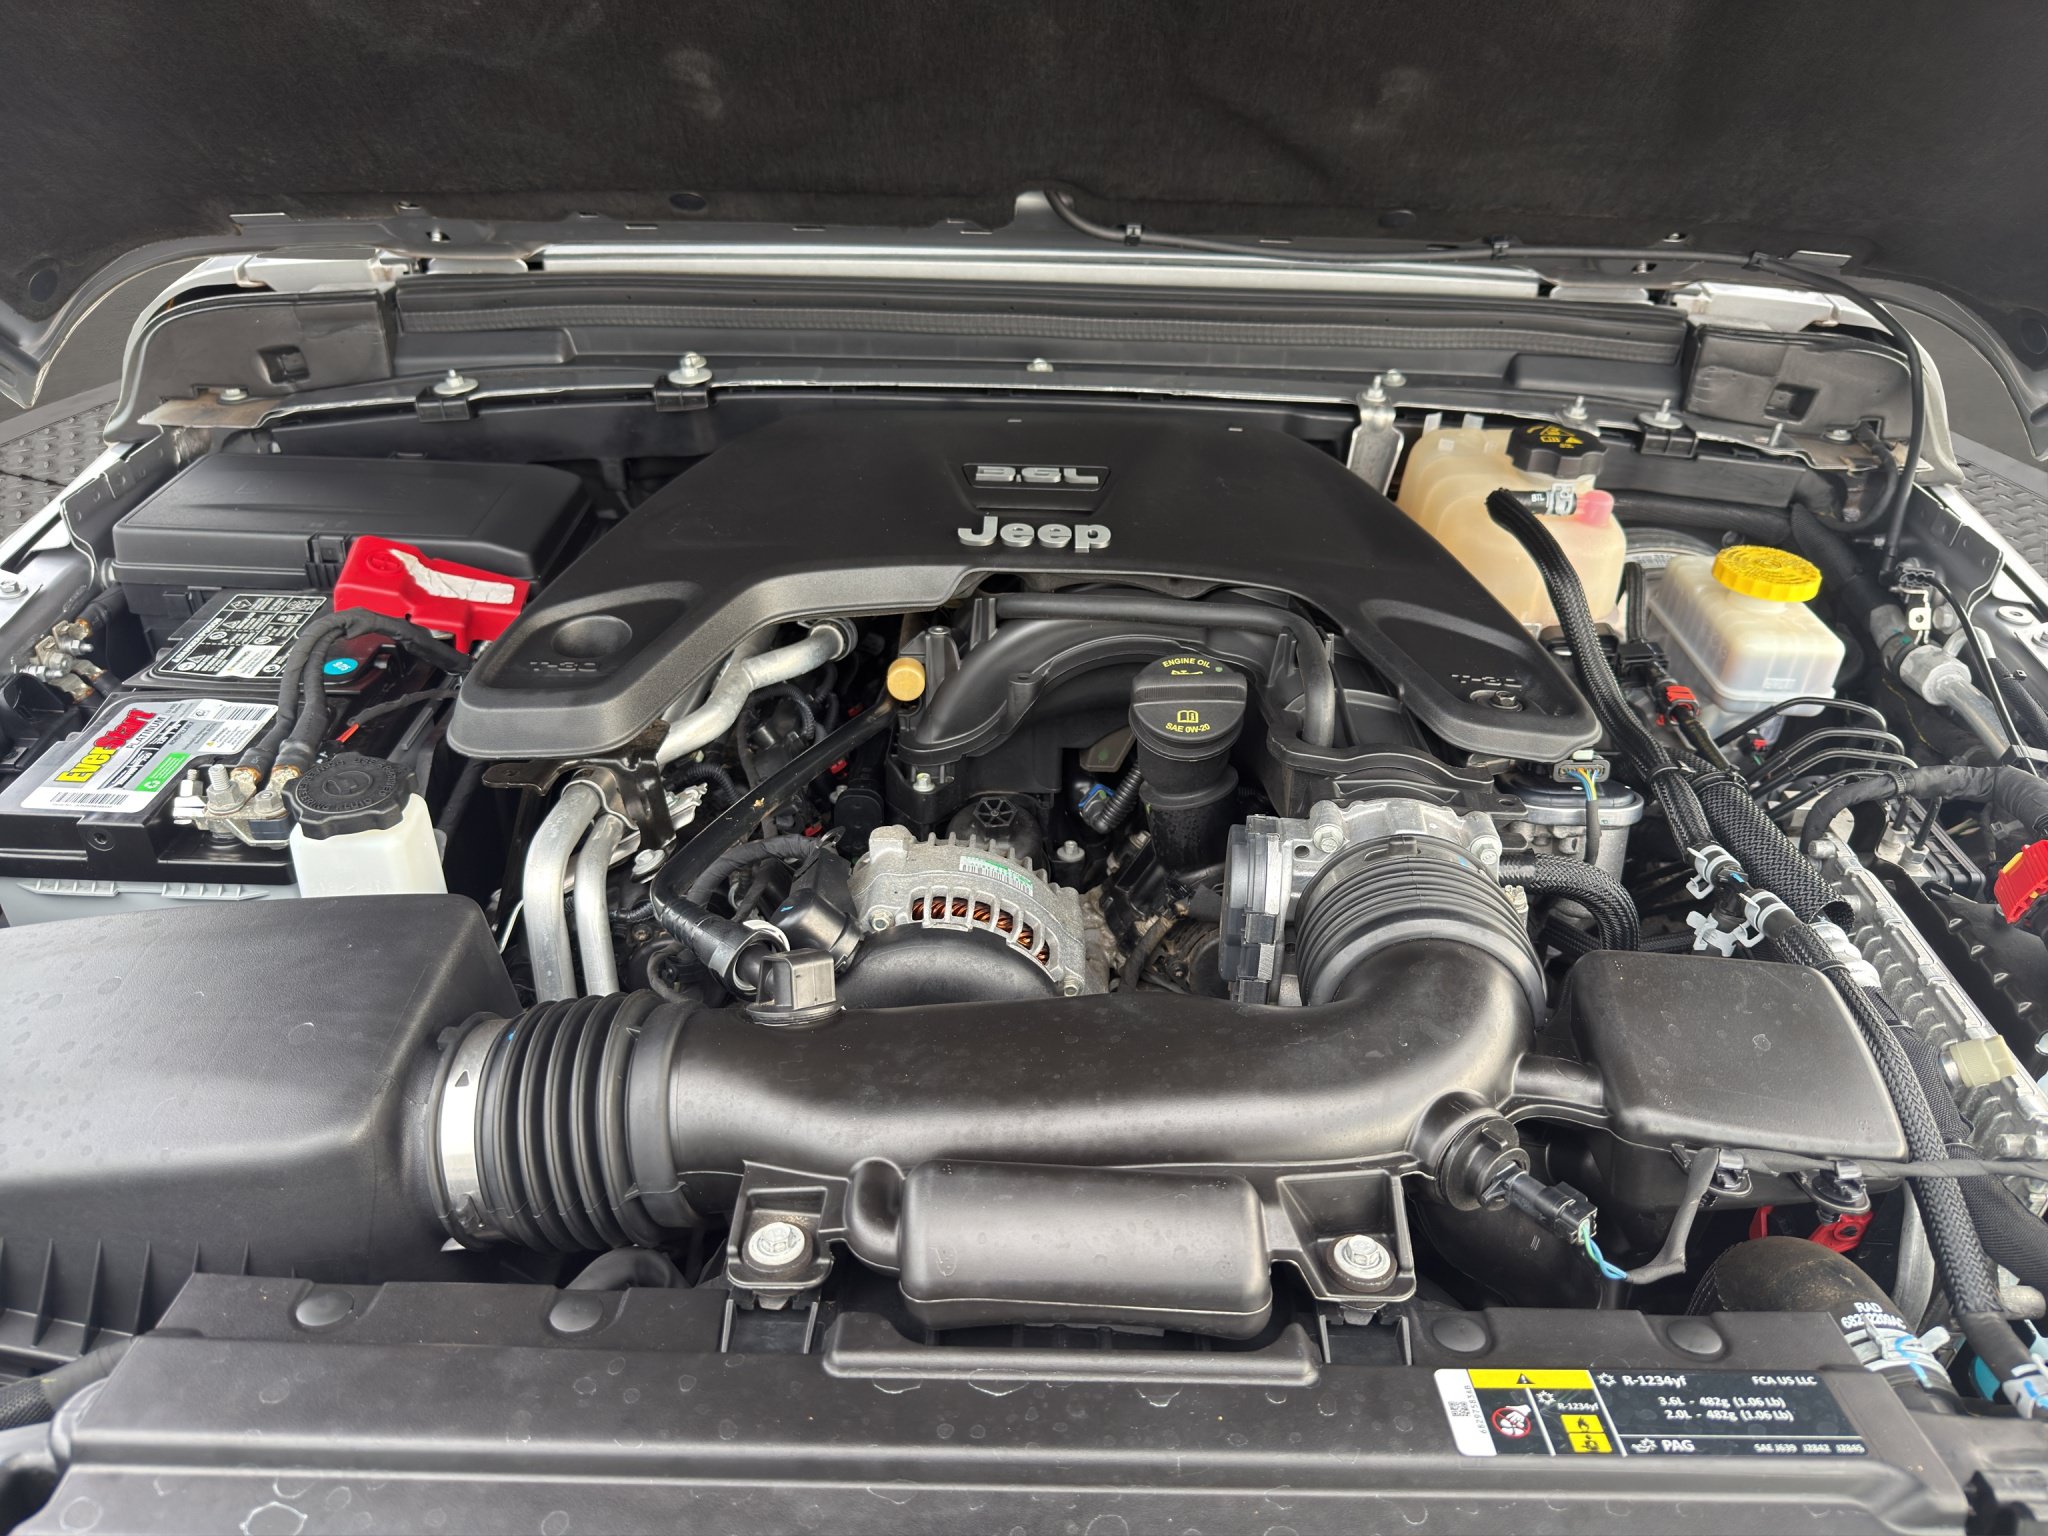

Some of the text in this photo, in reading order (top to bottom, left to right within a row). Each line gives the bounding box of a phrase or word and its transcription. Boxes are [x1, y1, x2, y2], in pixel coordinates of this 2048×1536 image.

[975, 465, 1099, 485] 3.6L
[1531, 493, 1545, 503] BTL
[957, 515, 1112, 553] Jeep
[1162, 658, 1211, 668] ENGINE OIL
[126, 715, 167, 749] PLATINUM
[1165, 722, 1211, 733] SAE 0W-20
[54, 708, 157, 783] EverStart
[1854, 1302, 1883, 1313] RAD
[1622, 1375, 1687, 1387] R-1234yf
[1752, 1376, 1817, 1386] FCA US LLC
[1658, 1396, 1684, 1407] 3.6L
[1700, 1397, 1730, 1408] 482g
[1733, 1397, 1763, 1408] (1.06
[1765, 1397, 1786, 1408] Lb)
[1664, 1410, 1692, 1420] 2.0L
[1706, 1411, 1737, 1421] 482g
[1740, 1411, 1771, 1421] (1.06
[1773, 1411, 1794, 1422] Lb)
[1662, 1439, 1696, 1452] PAG
[1754, 1443, 1774, 1453] SAE
